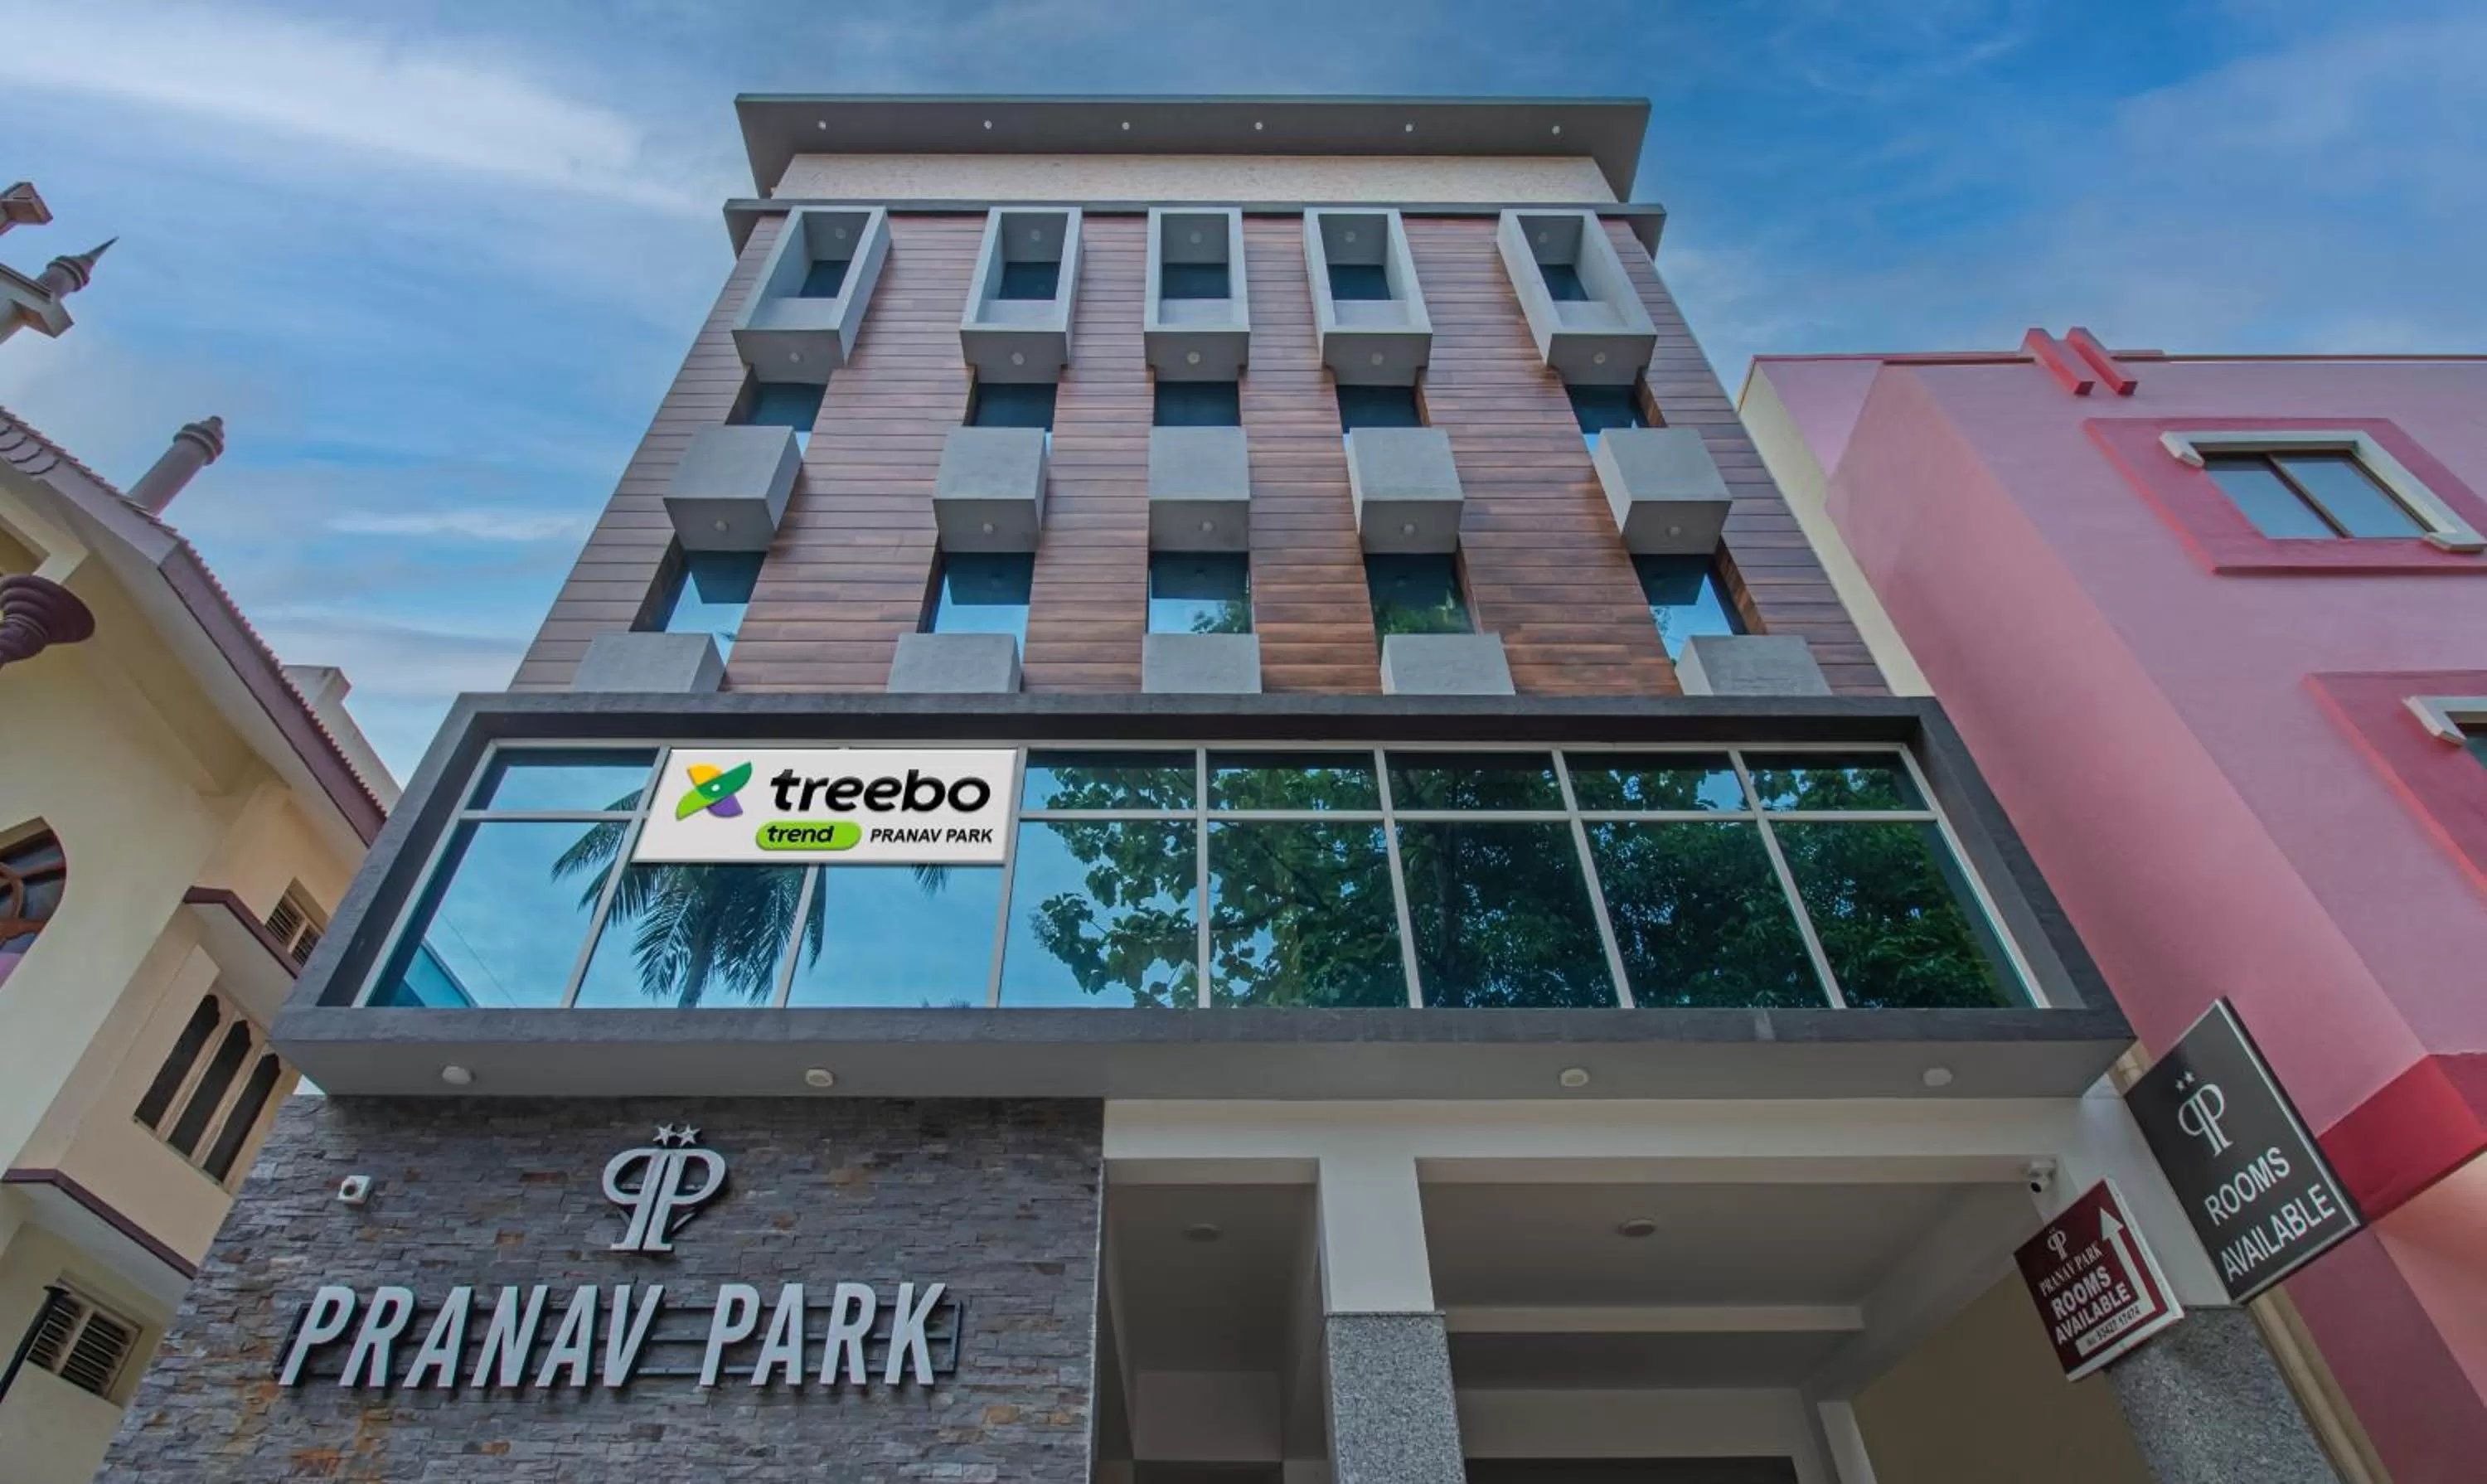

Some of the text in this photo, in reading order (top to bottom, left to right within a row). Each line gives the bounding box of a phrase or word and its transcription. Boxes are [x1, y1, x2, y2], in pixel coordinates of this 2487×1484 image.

[769, 769, 991, 812] treebo
[767, 825, 835, 844] trend
[870, 828, 994, 844] PRANAV PARK
[2204, 1147, 2291, 1226] ROOMS
[2220, 1184, 2336, 1283] AVAILABLE
[2039, 1240, 2103, 1297] PRANAV PARK
[2051, 1266, 2112, 1321] ROOMS
[279, 1282, 947, 1388] PRANAV PARK
[2056, 1281, 2131, 1346] AVAILABLE
